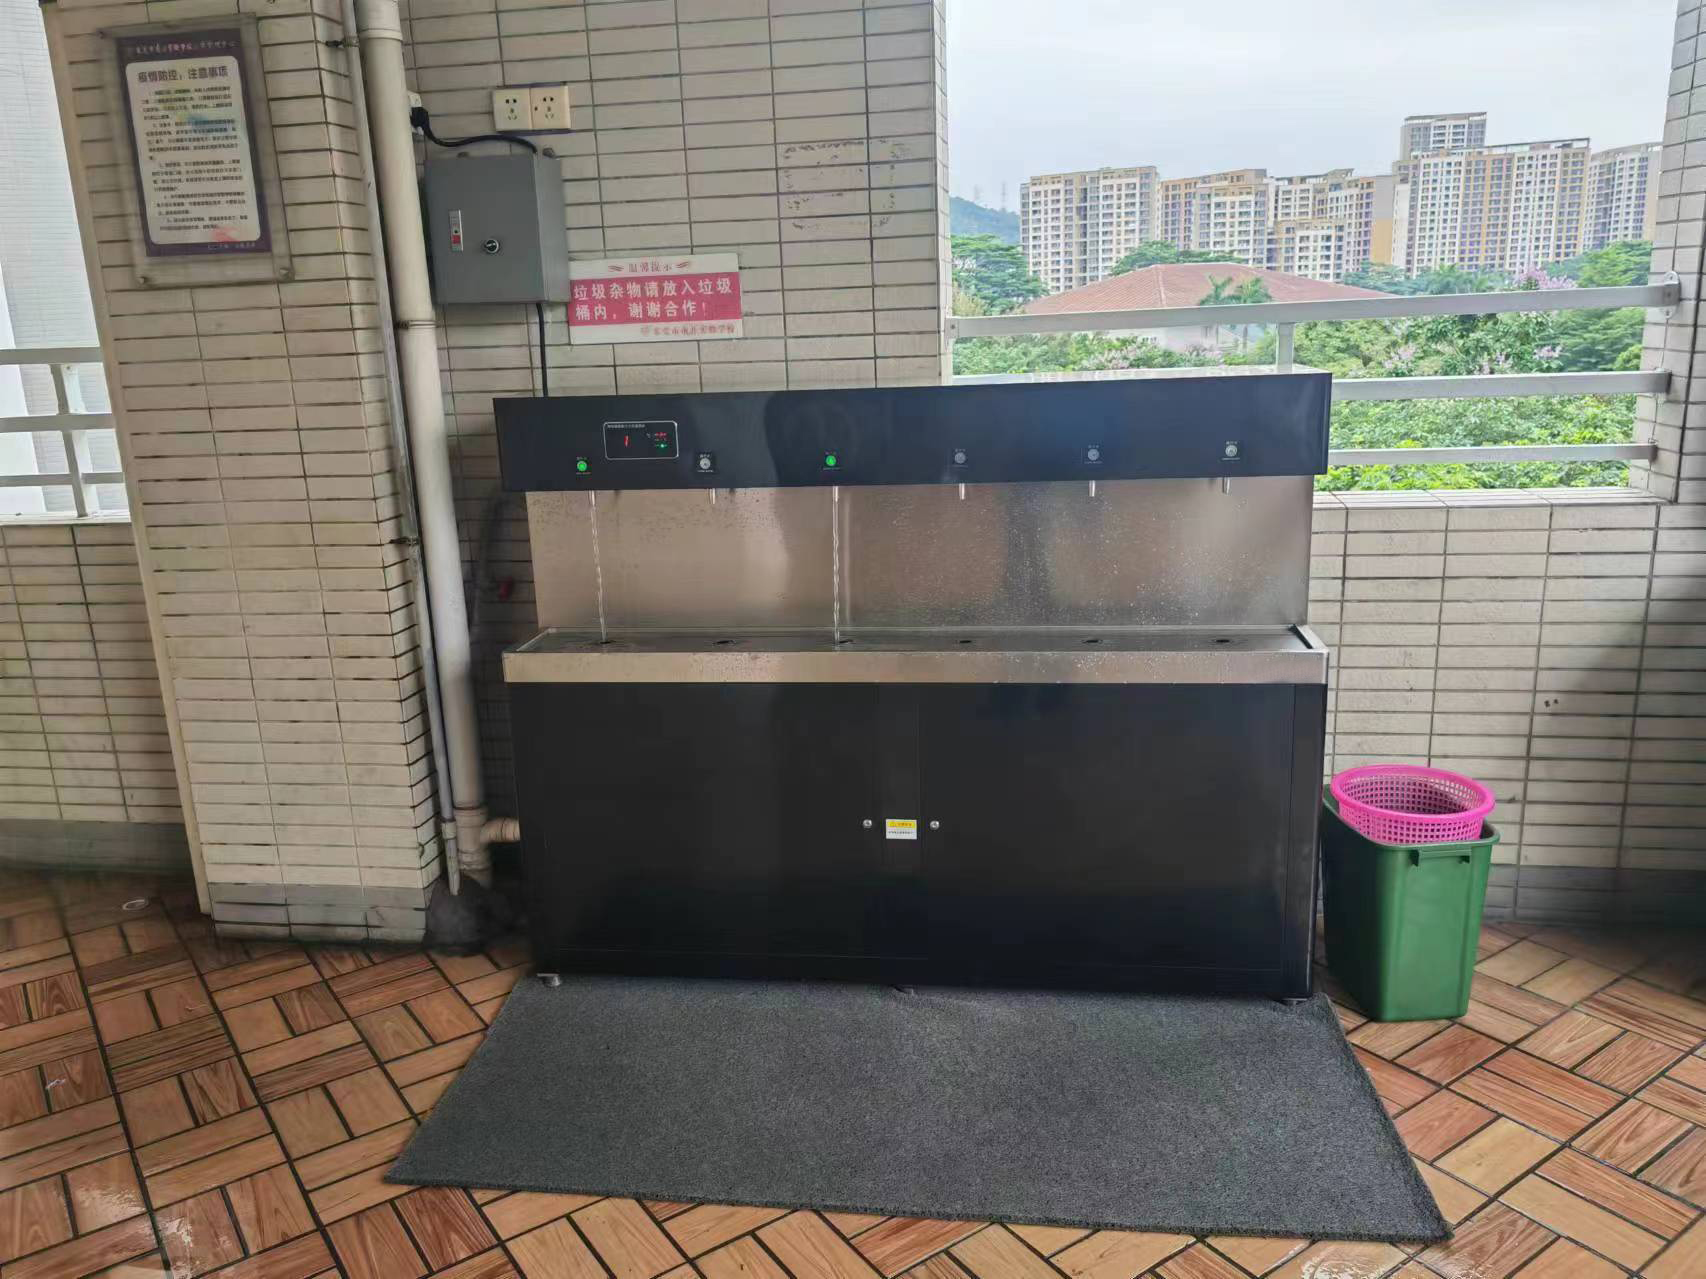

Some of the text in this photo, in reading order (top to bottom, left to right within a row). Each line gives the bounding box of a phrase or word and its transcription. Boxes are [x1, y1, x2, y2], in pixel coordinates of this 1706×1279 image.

[574, 277, 733, 301] 垃圾杂物请放入垃圾
